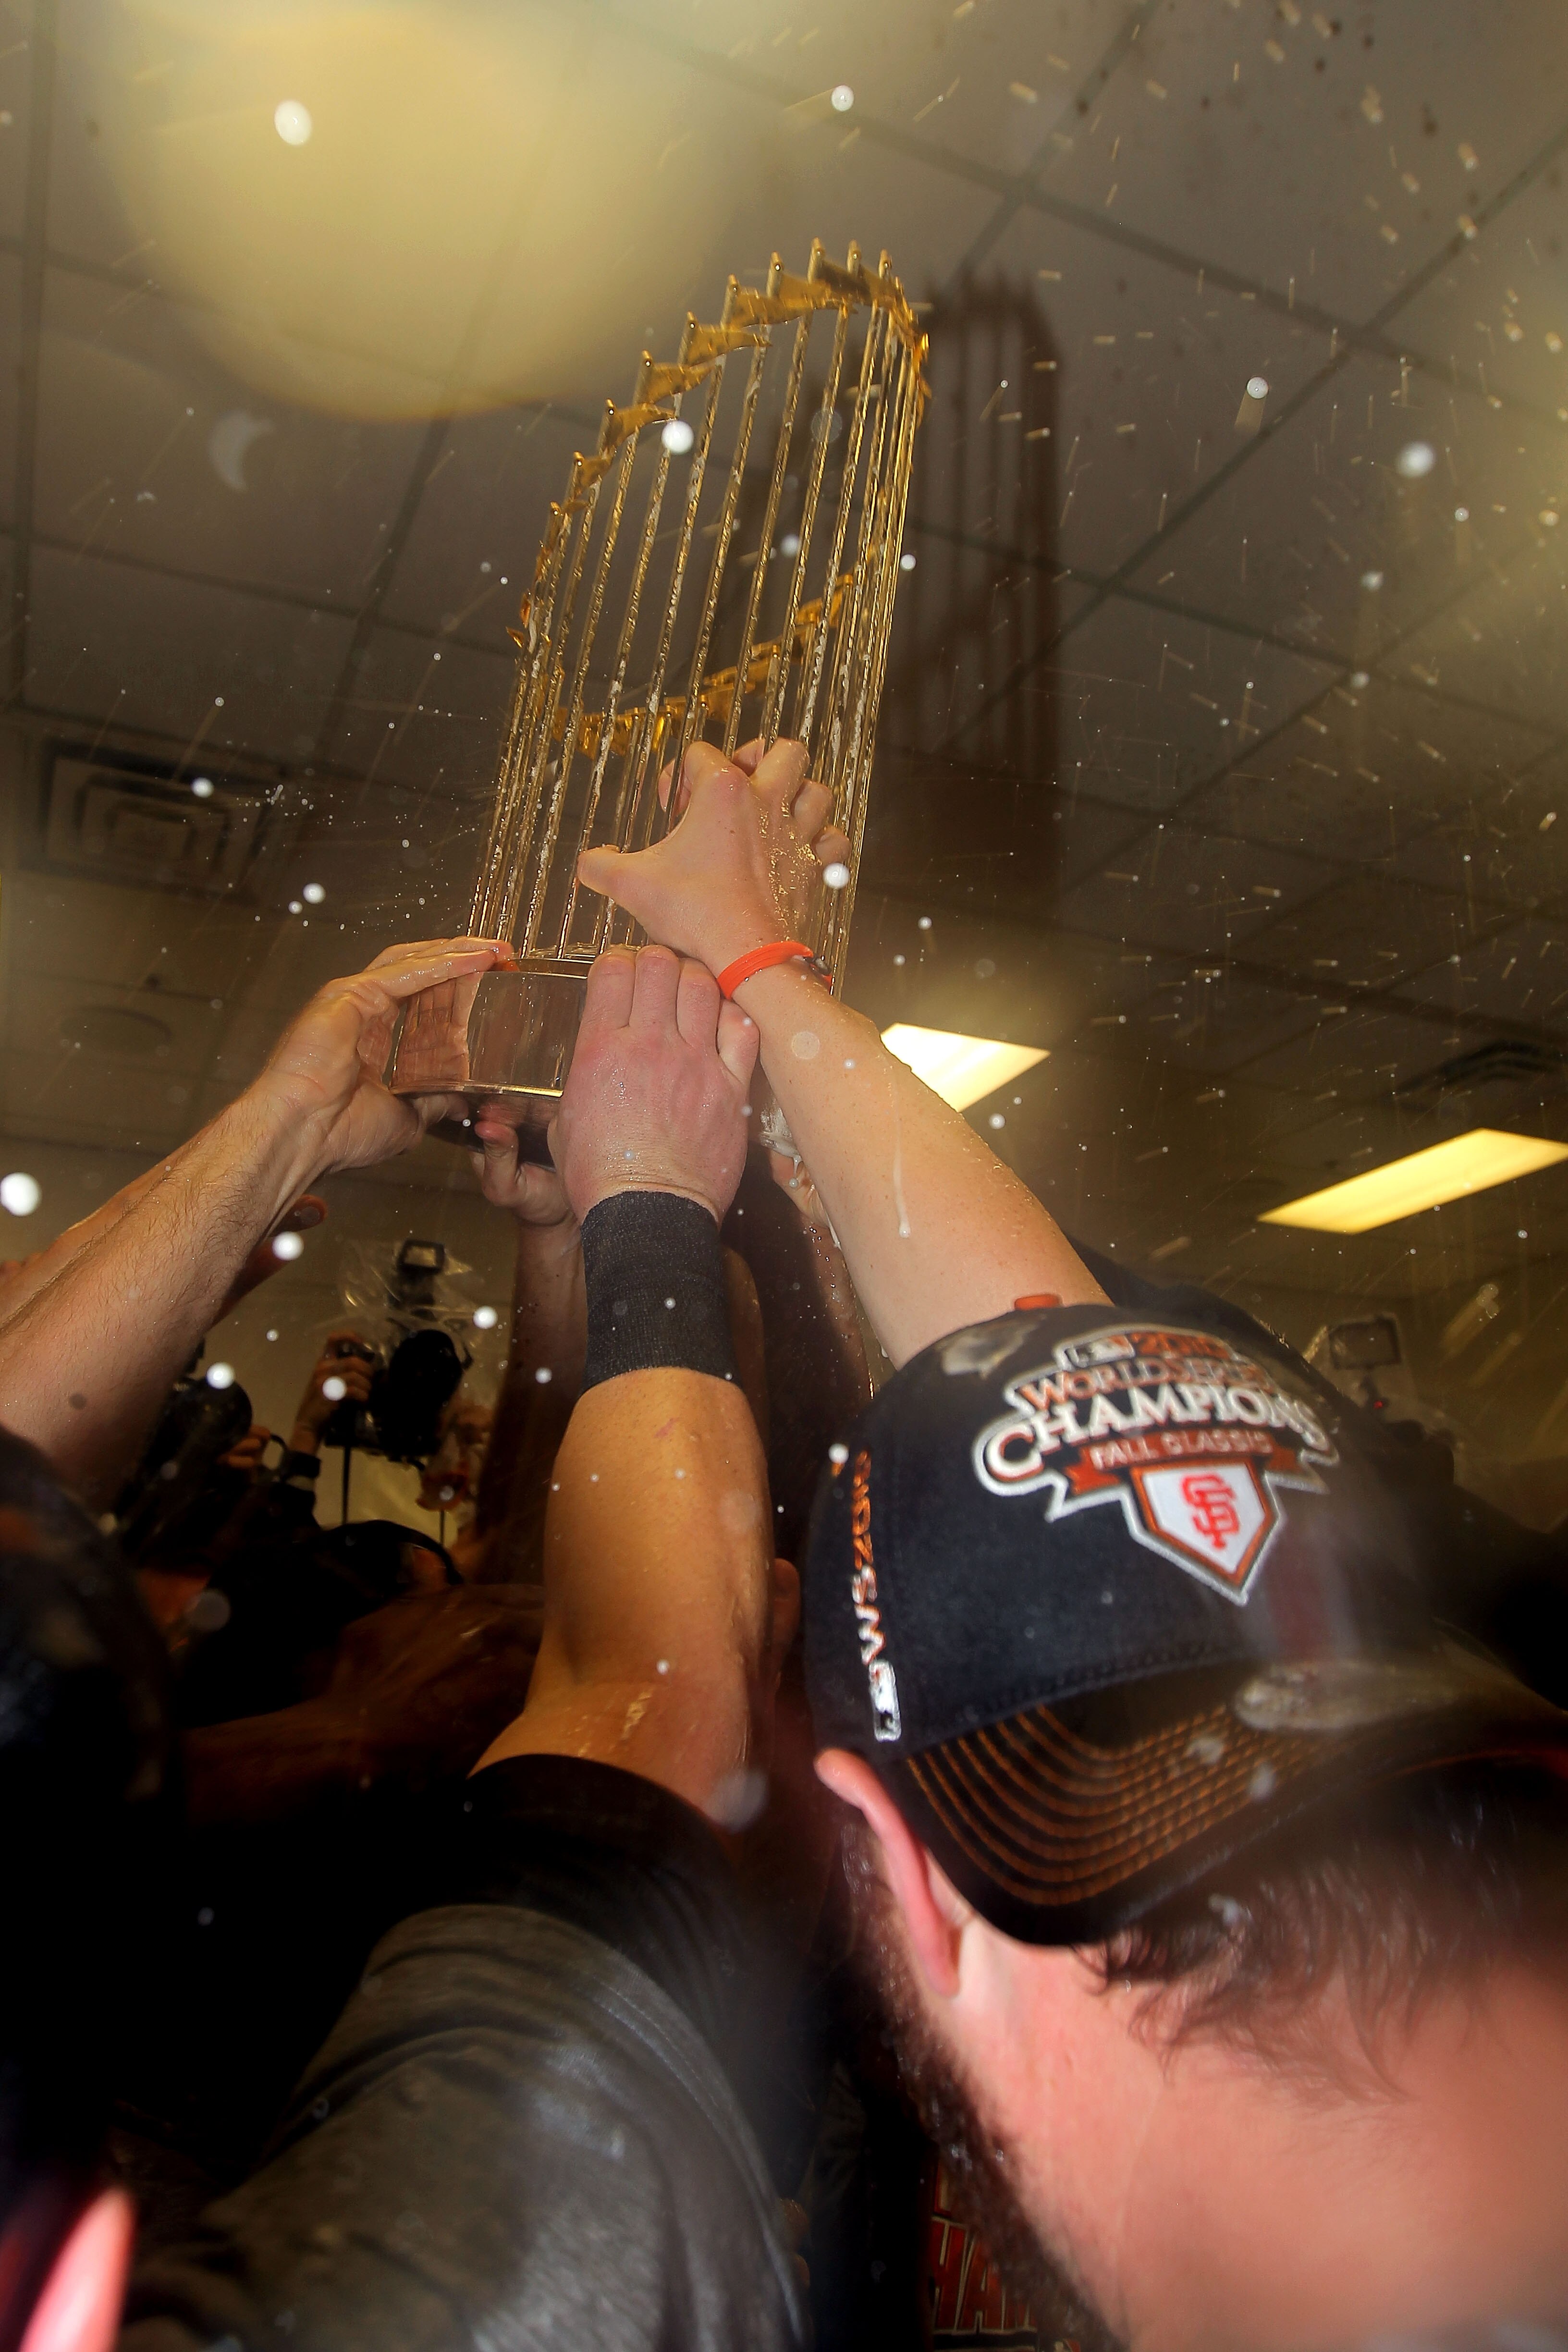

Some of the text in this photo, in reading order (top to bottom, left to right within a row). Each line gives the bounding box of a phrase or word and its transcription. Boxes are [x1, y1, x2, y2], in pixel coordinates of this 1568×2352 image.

[1014, 1356, 1274, 1411] WORLD SERIES
[985, 1382, 1330, 1481] CHAMPIONS
[1090, 1428, 1274, 1470] FALL CLASSIC
[1180, 1473, 1240, 1549] SF
